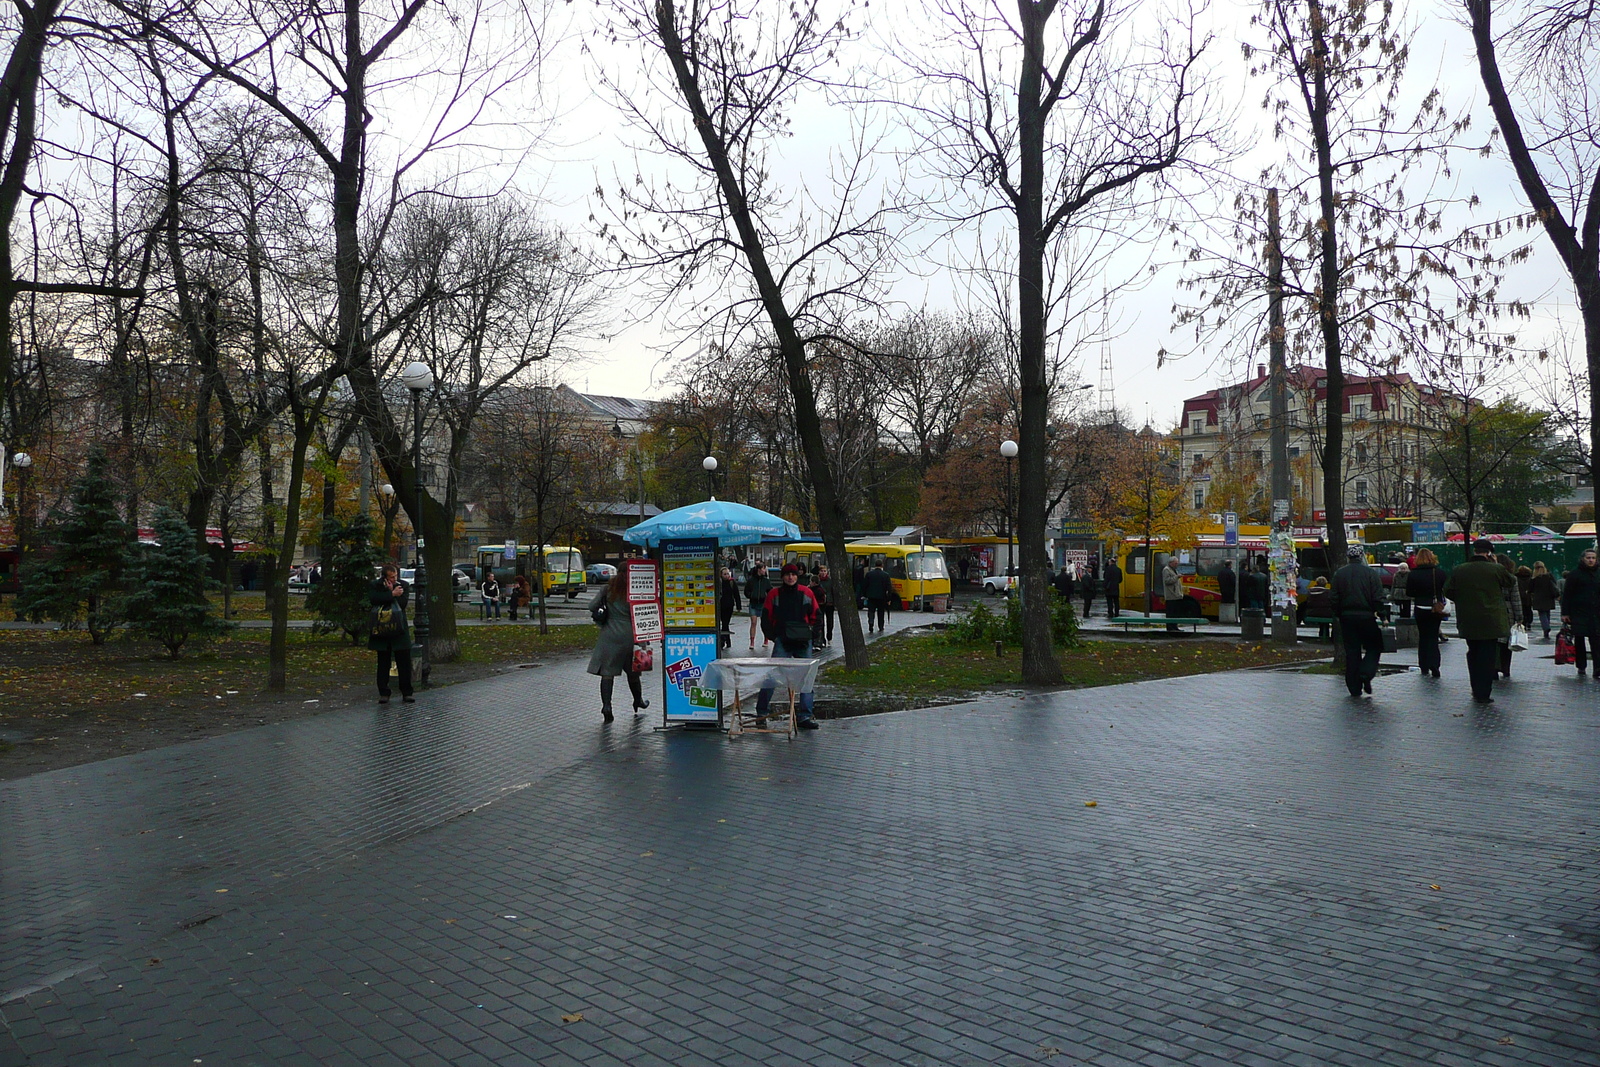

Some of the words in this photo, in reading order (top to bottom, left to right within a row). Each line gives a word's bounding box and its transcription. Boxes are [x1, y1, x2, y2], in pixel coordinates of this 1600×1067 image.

[666, 522, 722, 532] КИЇВСТАР
[636, 620, 660, 629] 100-250
[667, 635, 715, 646] ПРИДБАЙ
[667, 645, 699, 656] ТУТ!
[679, 659, 691, 670] 25
[689, 668, 700, 677] 50
